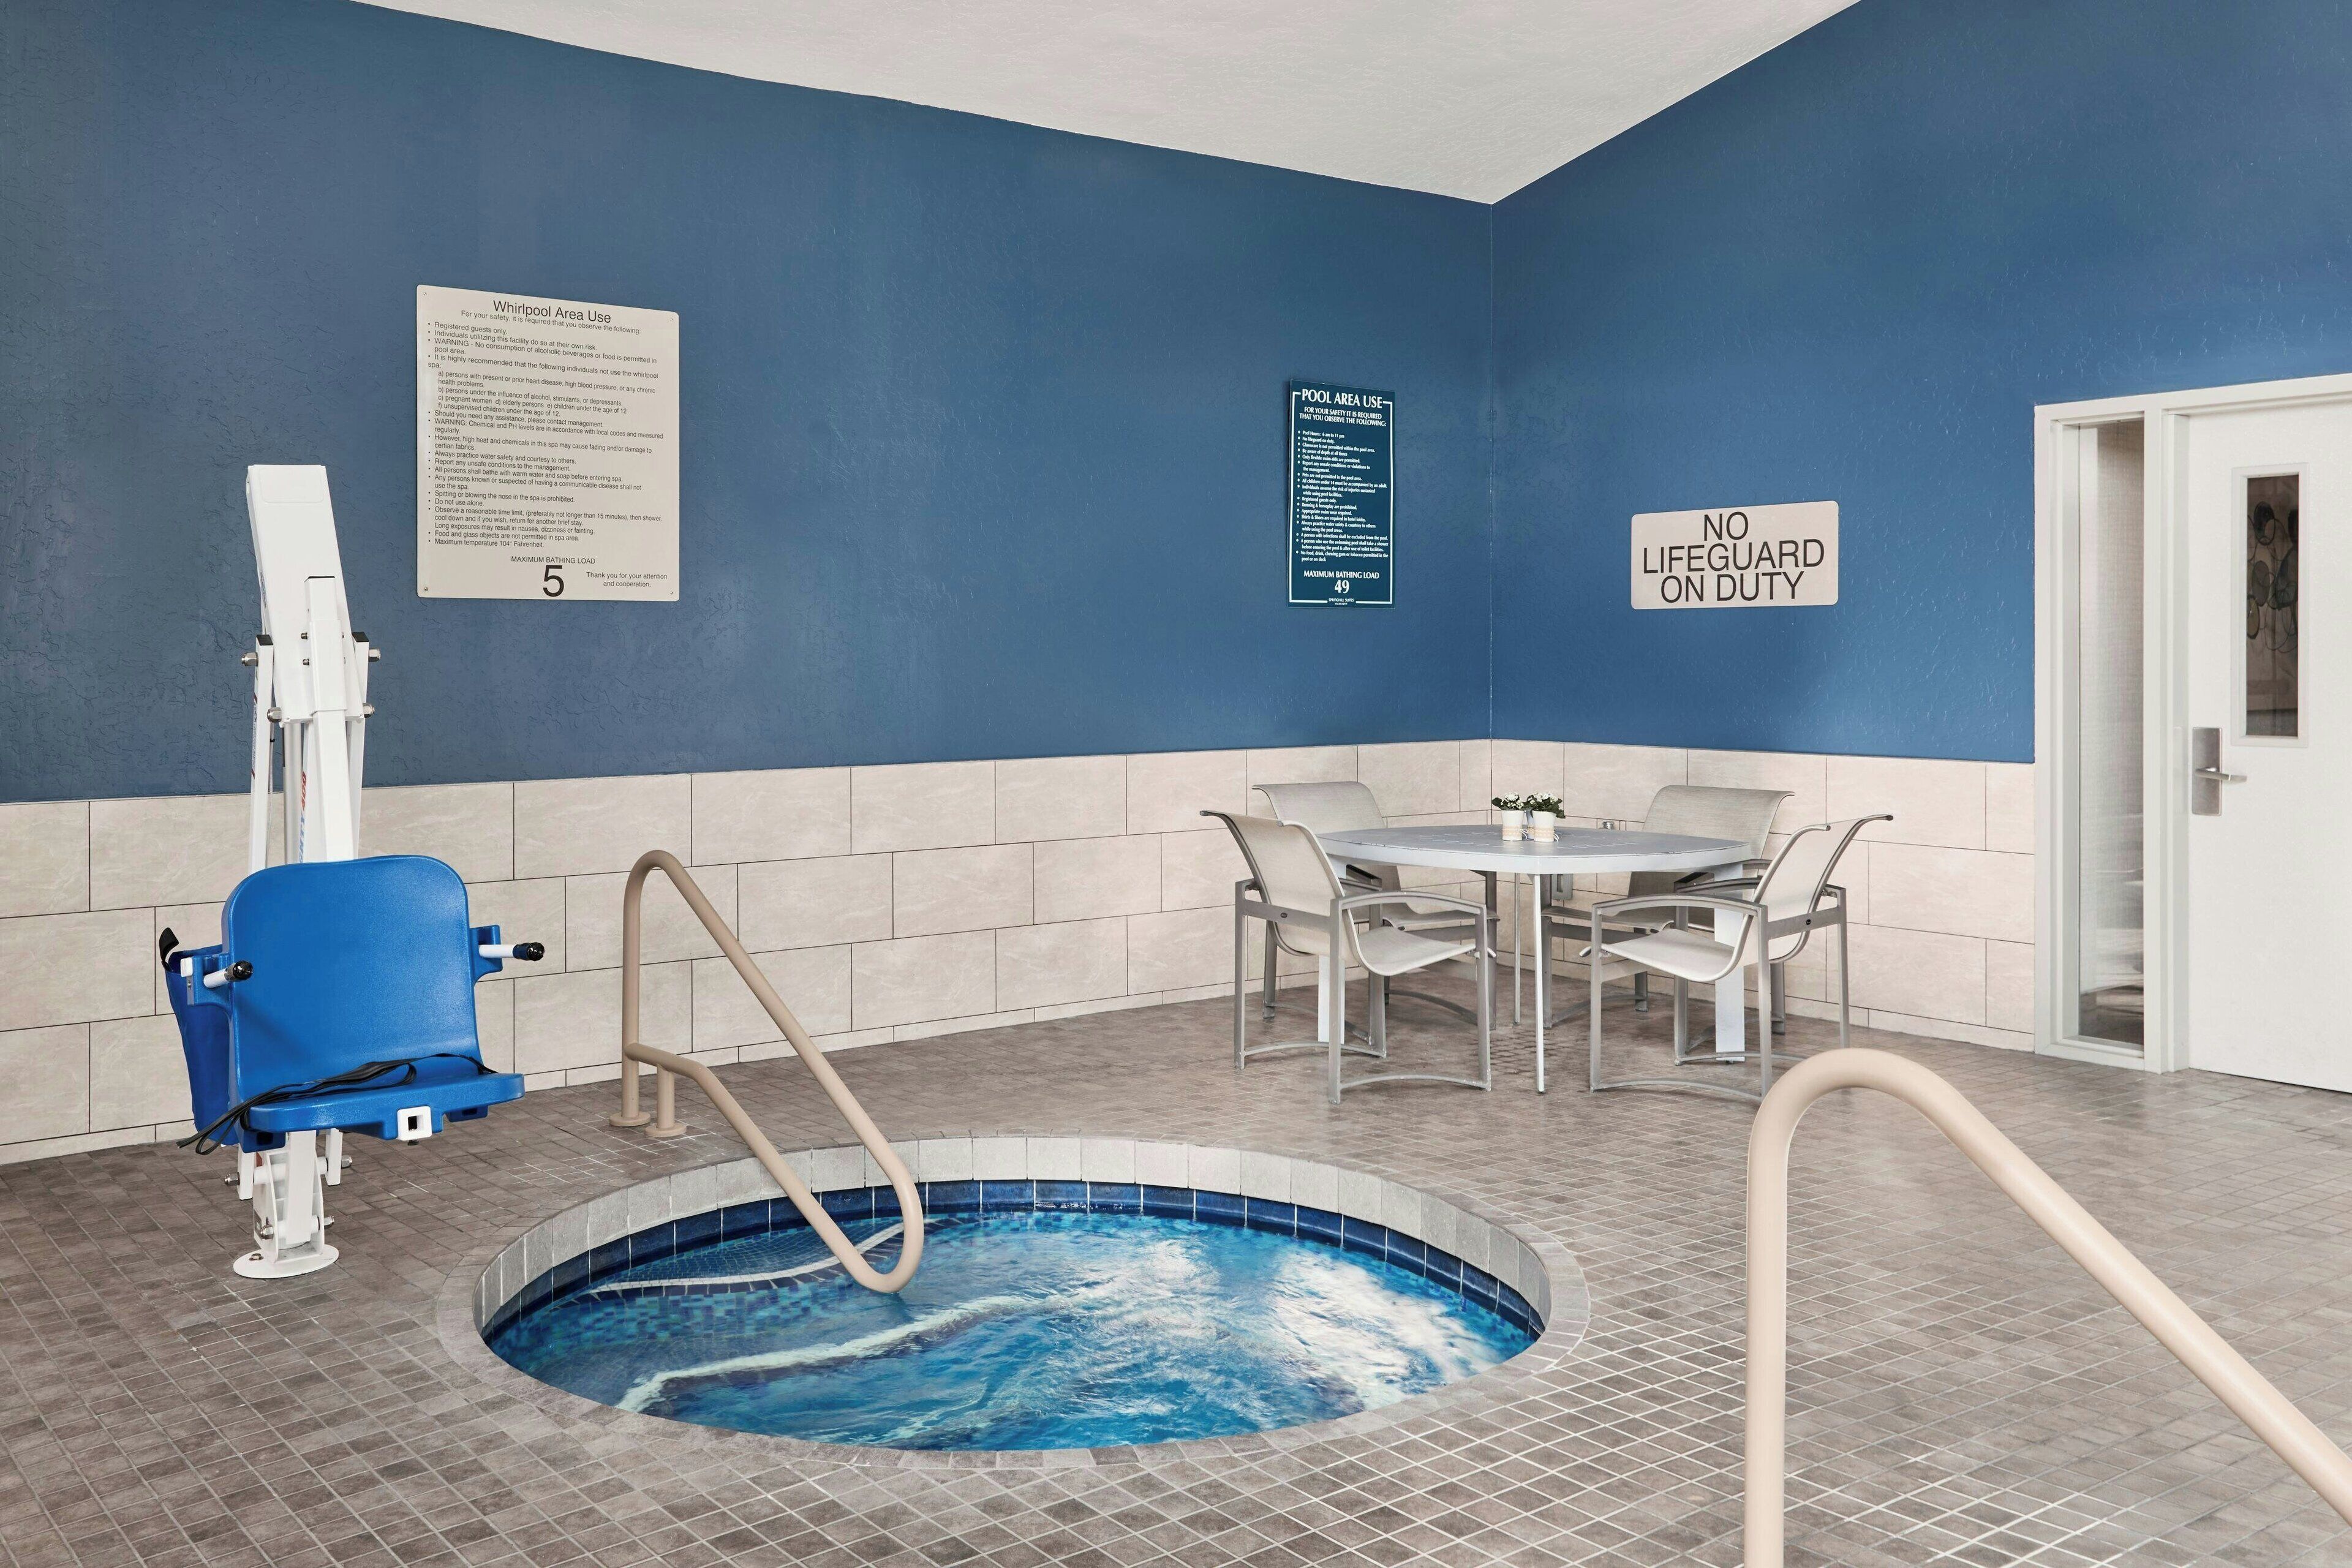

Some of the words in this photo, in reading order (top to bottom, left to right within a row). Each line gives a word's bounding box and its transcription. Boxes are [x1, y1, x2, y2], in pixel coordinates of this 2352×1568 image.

[493, 300, 551, 317] Whirlpool
[555, 307, 584, 320] Area
[588, 310, 611, 323] Use
[434, 322, 469, 331] Registered
[434, 330, 468, 339] Individuals
[468, 333, 496, 342] utilitzing
[510, 336, 529, 345] facility
[1302, 388, 1332, 404] POOL
[1333, 392, 1360, 406] AREA
[1363, 395, 1382, 409] USE
[456, 450, 479, 459] practice
[434, 489, 456, 498] Spitting
[465, 491, 486, 500] blowing
[1704, 511, 1748, 541] NO
[1643, 539, 1824, 573] LIFEGUARD
[543, 564, 564, 597] 5
[1334, 579, 1349, 594] 49
[1661, 575, 1704, 603] ON
[1717, 571, 1804, 601] DUTY
